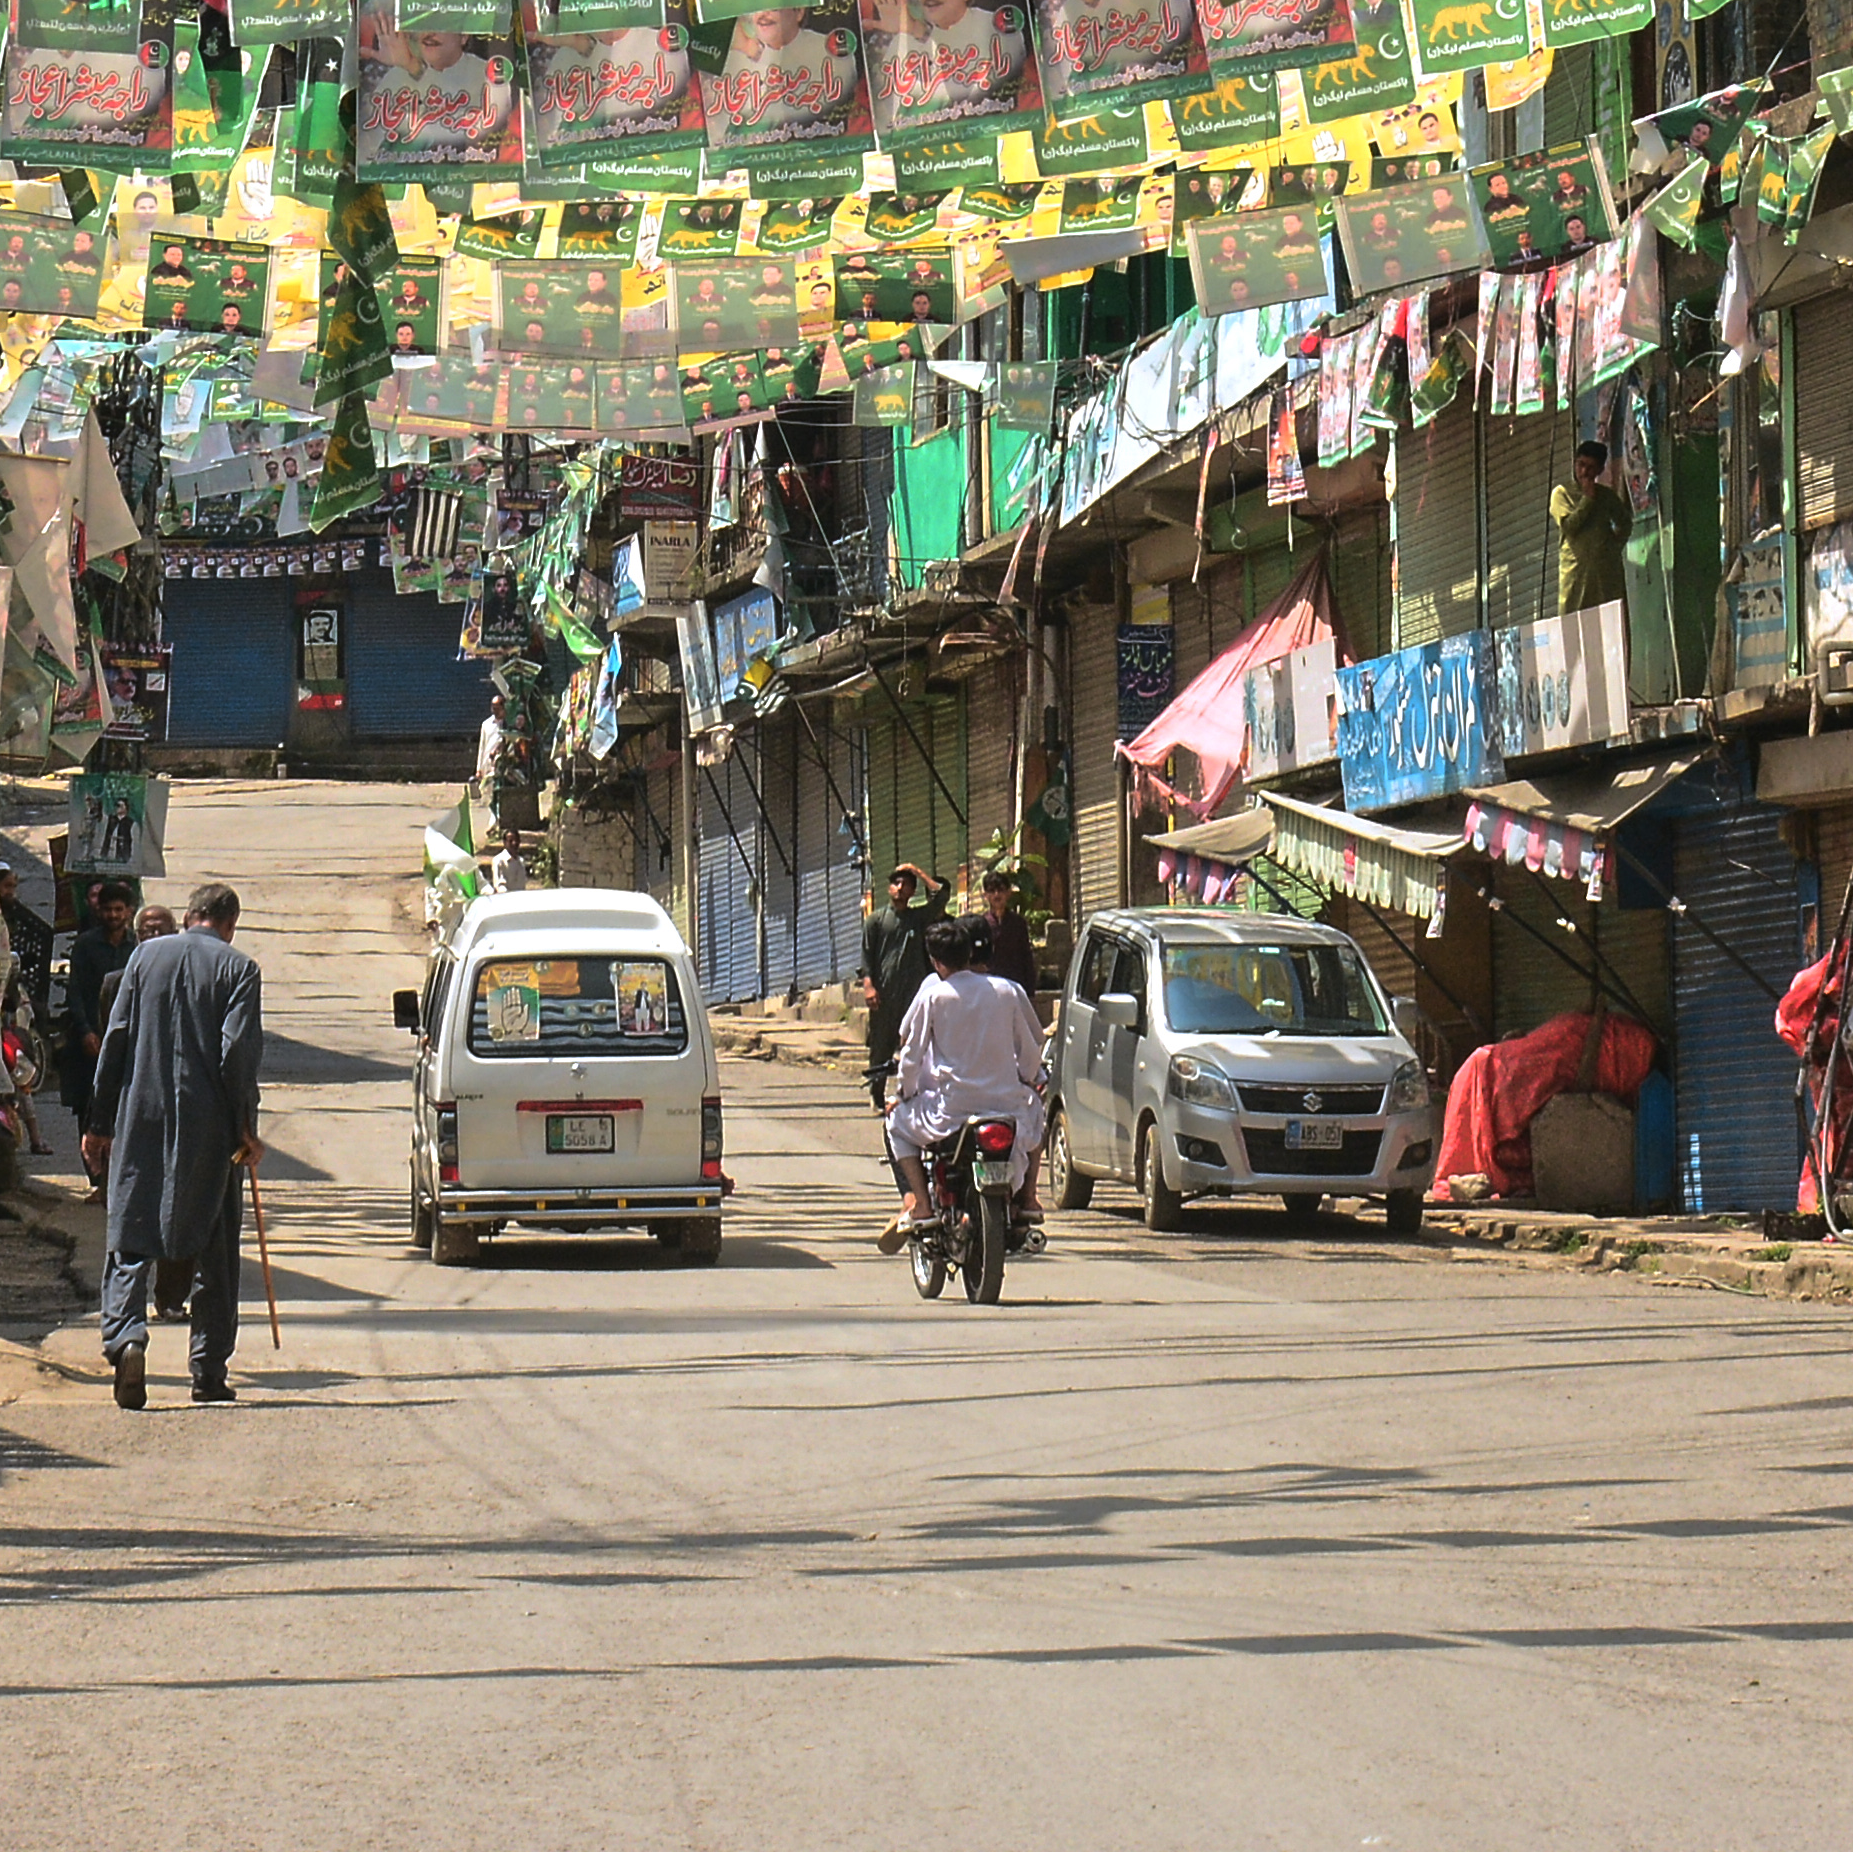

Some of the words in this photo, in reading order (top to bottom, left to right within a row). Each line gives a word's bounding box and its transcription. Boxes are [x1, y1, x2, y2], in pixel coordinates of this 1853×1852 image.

[966, 35, 1012, 91] راجہ
[1048, 12, 1101, 74] اعجاز
[1089, 8, 1148, 73] مبشر
[539, 66, 593, 123] اعجاز
[580, 60, 643, 122] مبشر
[628, 52, 676, 109] راجہ
[877, 49, 932, 109] اعجاز
[918, 44, 979, 107] مبشر
[668, 459, 697, 488] رضا
